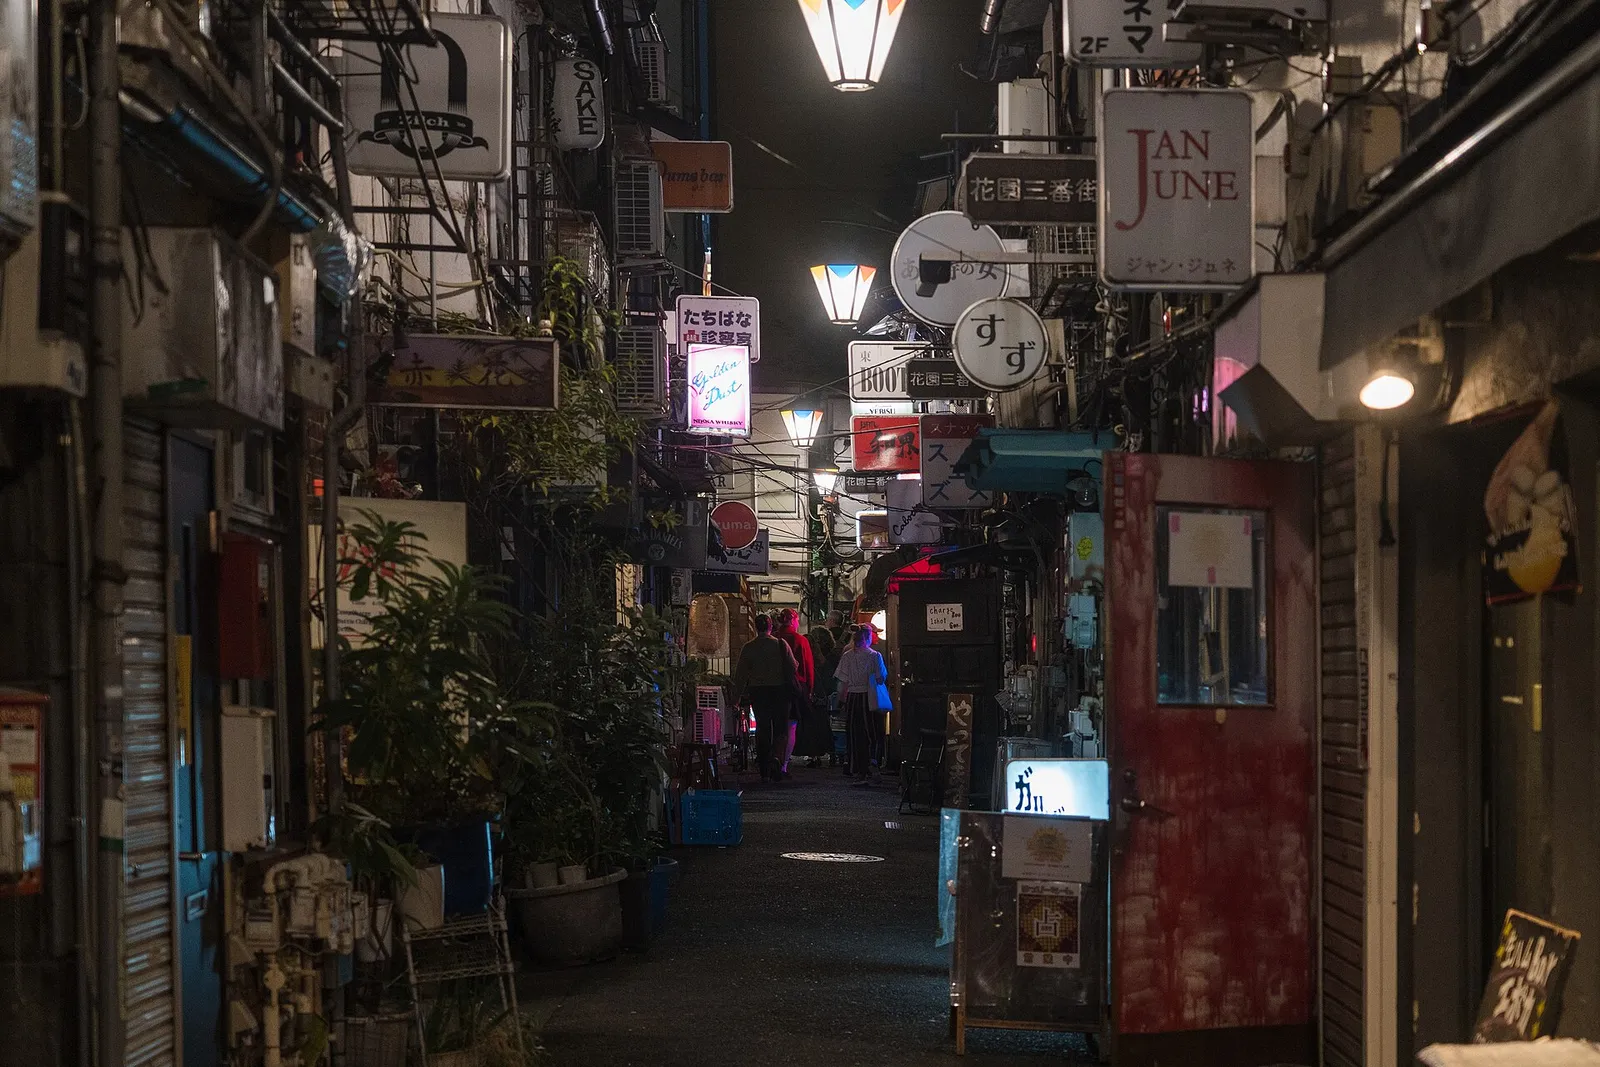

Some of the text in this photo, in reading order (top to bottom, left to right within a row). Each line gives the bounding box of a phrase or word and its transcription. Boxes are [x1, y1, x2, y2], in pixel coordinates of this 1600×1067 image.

[1080, 37, 1109, 54] 2F
[573, 61, 598, 136] SAKE
[970, 176, 1098, 203] 花園三番街
[684, 309, 752, 328] たちばな
[971, 314, 1036, 376] すず
[692, 360, 741, 394] Golden
[703, 380, 743, 411] Dust
